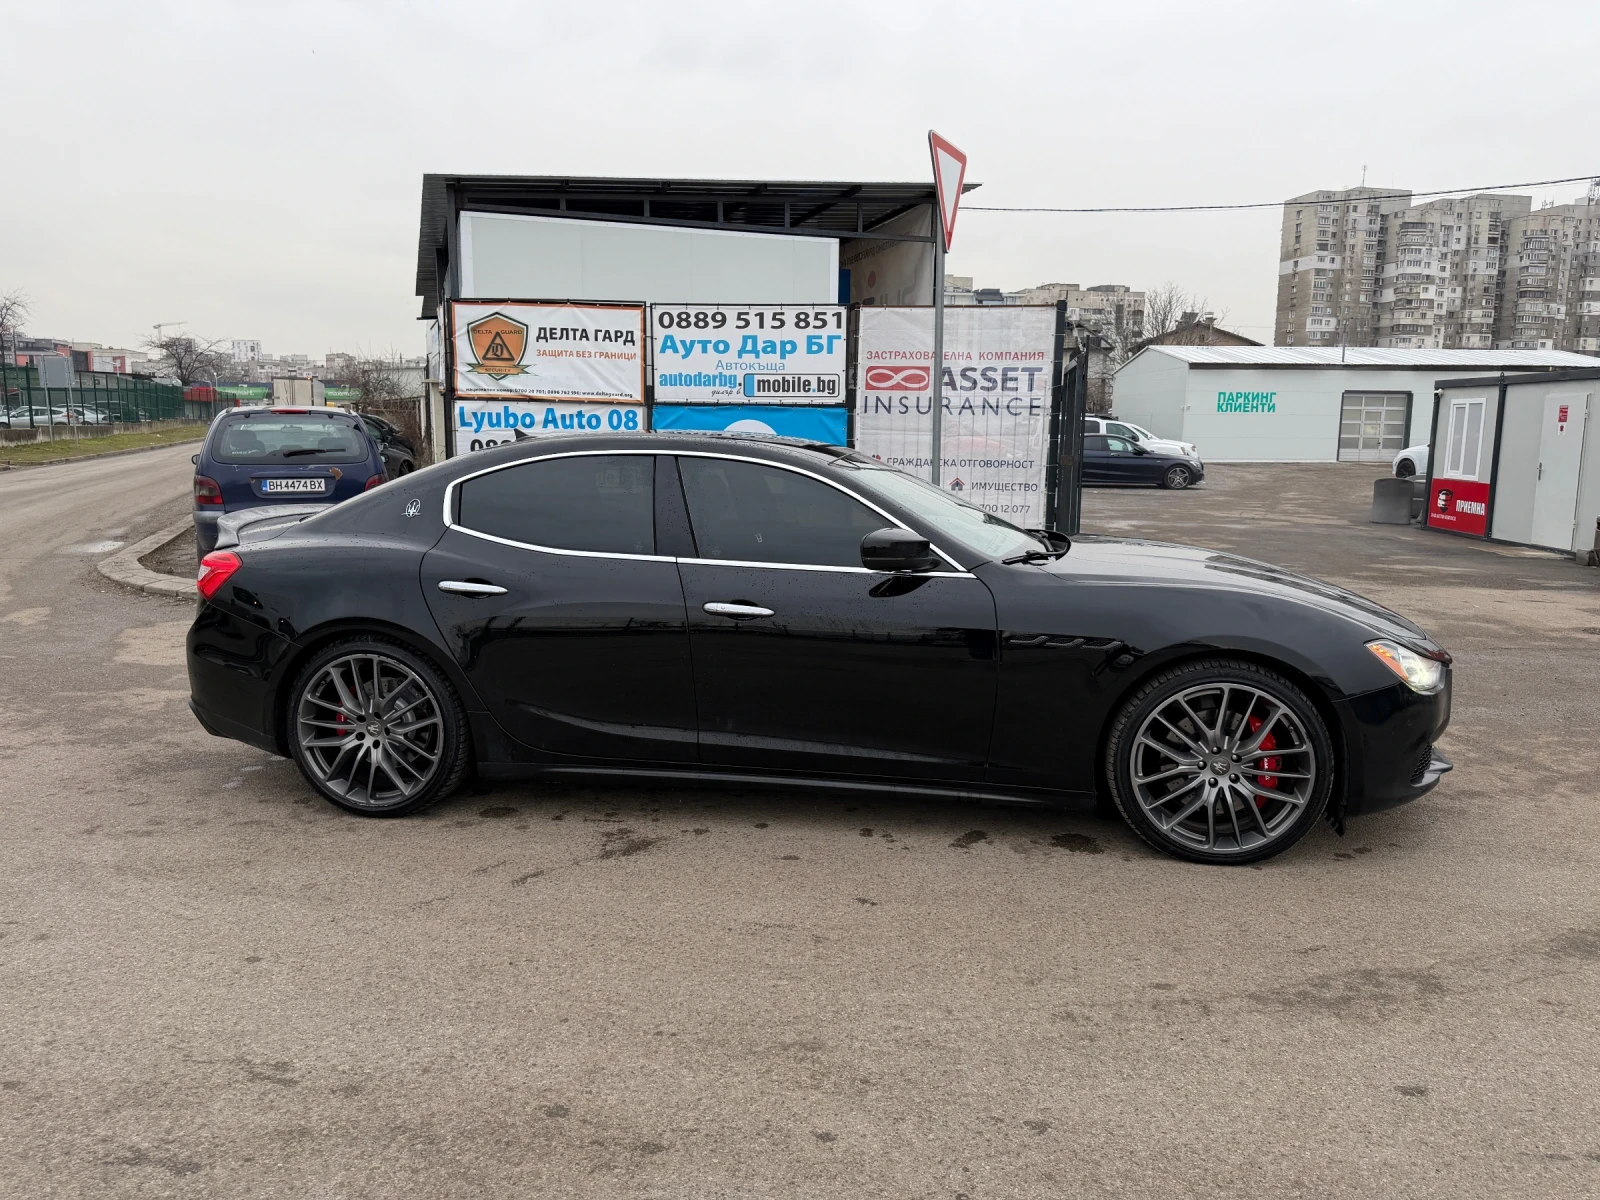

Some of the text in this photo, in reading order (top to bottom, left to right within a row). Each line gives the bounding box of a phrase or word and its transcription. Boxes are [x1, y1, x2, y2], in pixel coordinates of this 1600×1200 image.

[658, 311, 842, 329] 0889 515 851
[536, 327, 636, 346] ДЕЛТА ГАРД
[659, 335, 842, 360] Ауто Дар БГ
[536, 349, 637, 361] ЗАЩИТА БЕЗ ГРАНИЦИ
[866, 351, 1045, 361] ЗАСТРАХОВАЕЛНА КОМПАНИЯ
[715, 360, 786, 372] Автокъща
[757, 377, 836, 395] mobile.bg
[941, 366, 1043, 392] ASSET
[1218, 392, 1276, 403] ПАРКИНГ
[864, 395, 1042, 416] INSURANCE
[1217, 402, 1276, 412] КЛИЕНТИ
[459, 406, 639, 433] Lyubo Auto 08
[959, 459, 1035, 469] ОТГОВОРНОСТ
[971, 482, 1038, 492] ИМУЩЕСТВО
[1000, 504, 1010, 513] 12
[1012, 504, 1031, 514] 077
[1455, 499, 1486, 516] ПРИЕМНА
